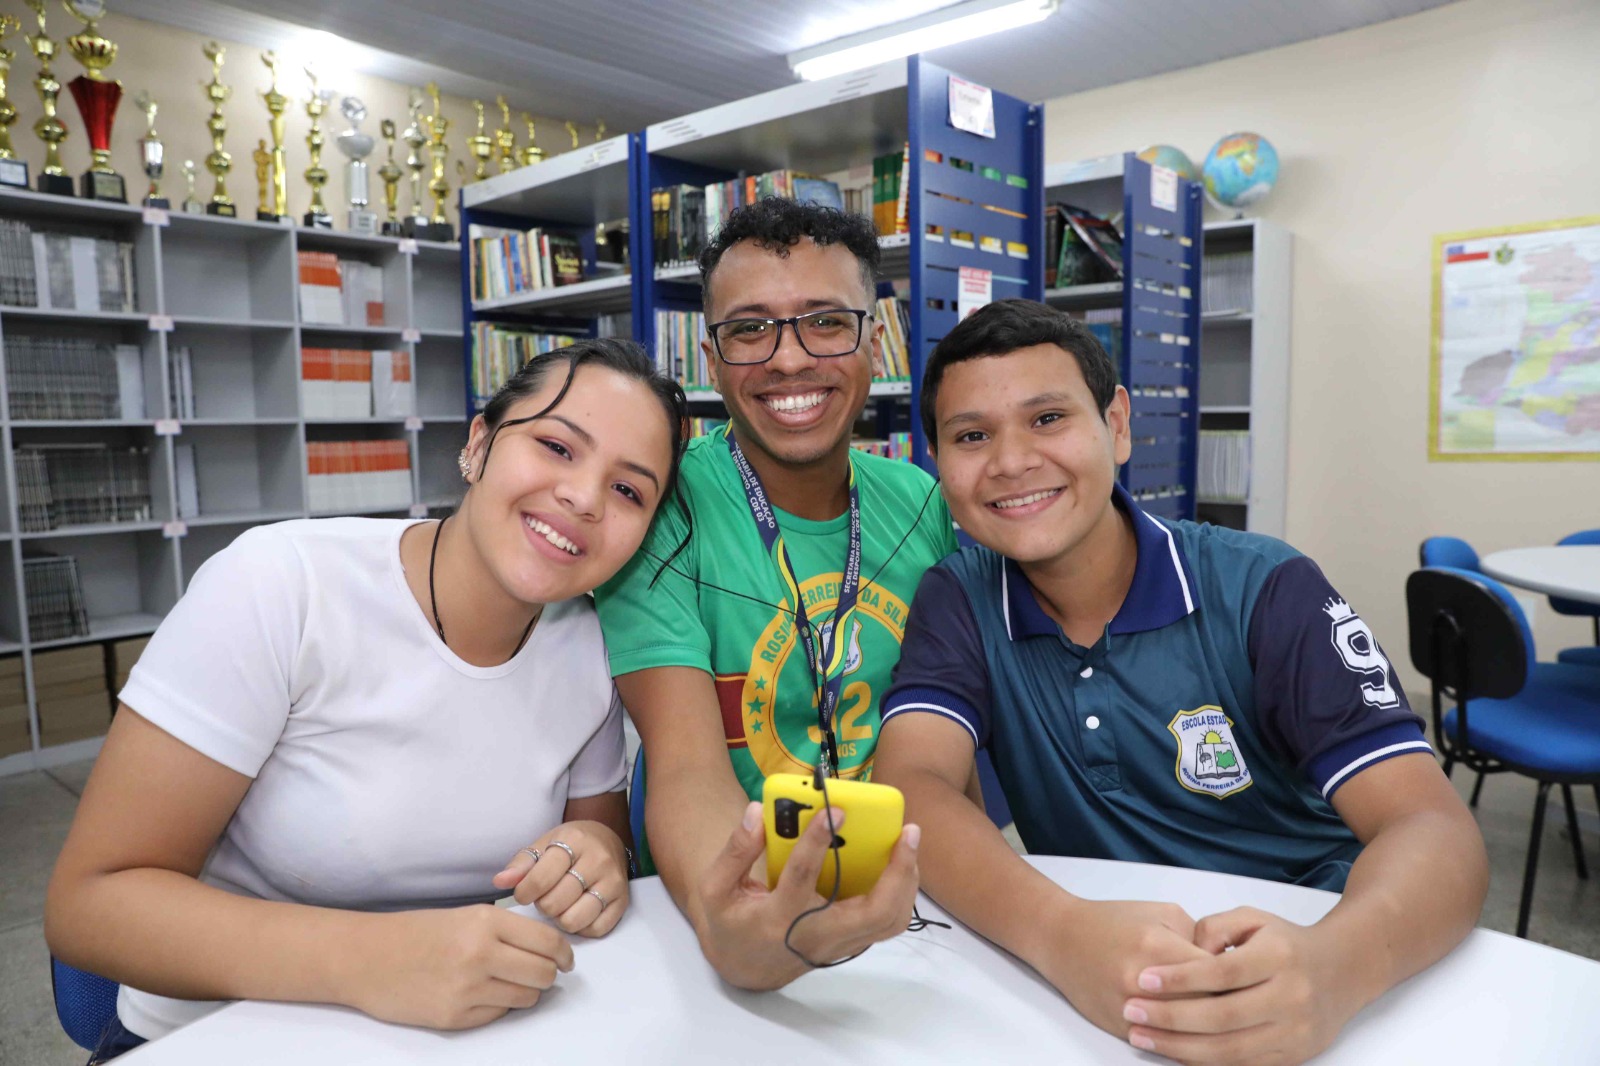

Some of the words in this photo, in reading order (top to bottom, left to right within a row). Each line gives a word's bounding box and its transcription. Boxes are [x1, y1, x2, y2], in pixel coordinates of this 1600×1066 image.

[749, 476, 759, 487] DE
[754, 484, 775, 529] EDUCAÇÃO
[750, 496, 762, 513] CDE
[756, 511, 765, 522] 03
[843, 549, 856, 593] SECRETARIA
[851, 539, 856, 549] DE
[852, 541, 861, 581] DESPORTO
[861, 588, 879, 608] DA
[882, 600, 907, 631] SILV
[1330, 613, 1400, 710] 9
[1181, 715, 1207, 731] ESCOLA
[1202, 781, 1235, 790] FERREIRA
[1235, 775, 1244, 784] DA
